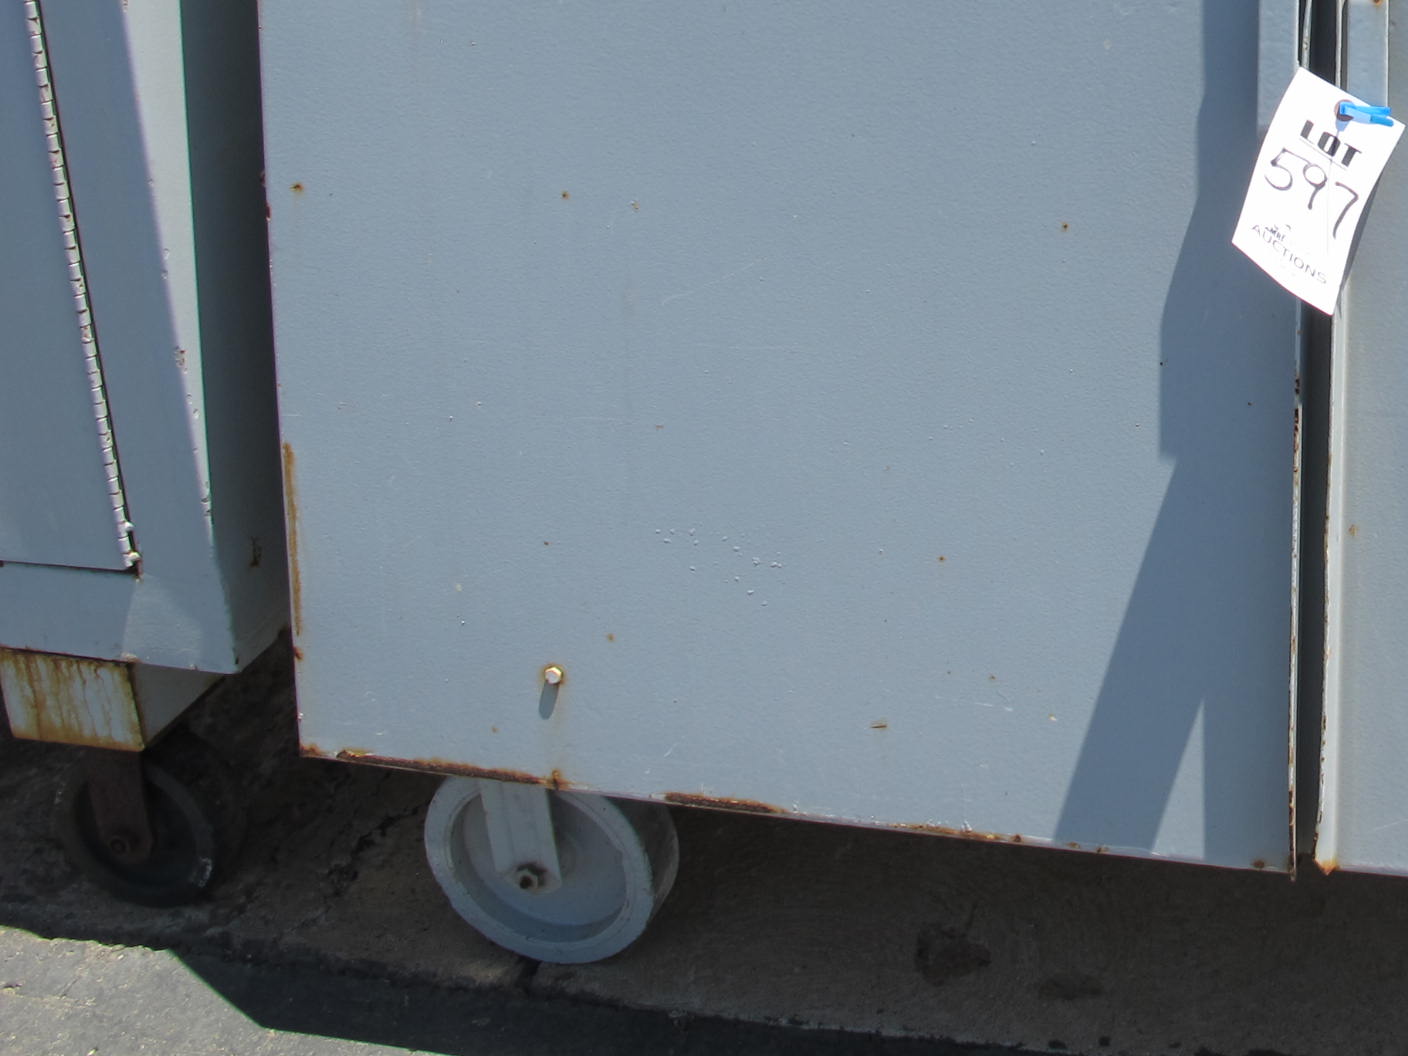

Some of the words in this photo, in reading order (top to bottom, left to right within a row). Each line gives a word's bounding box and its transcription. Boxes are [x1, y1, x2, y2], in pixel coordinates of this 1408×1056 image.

[1299, 119, 1362, 168] LOT
[1264, 147, 1360, 240] 597
[1251, 224, 1328, 285] AUCTIONS
